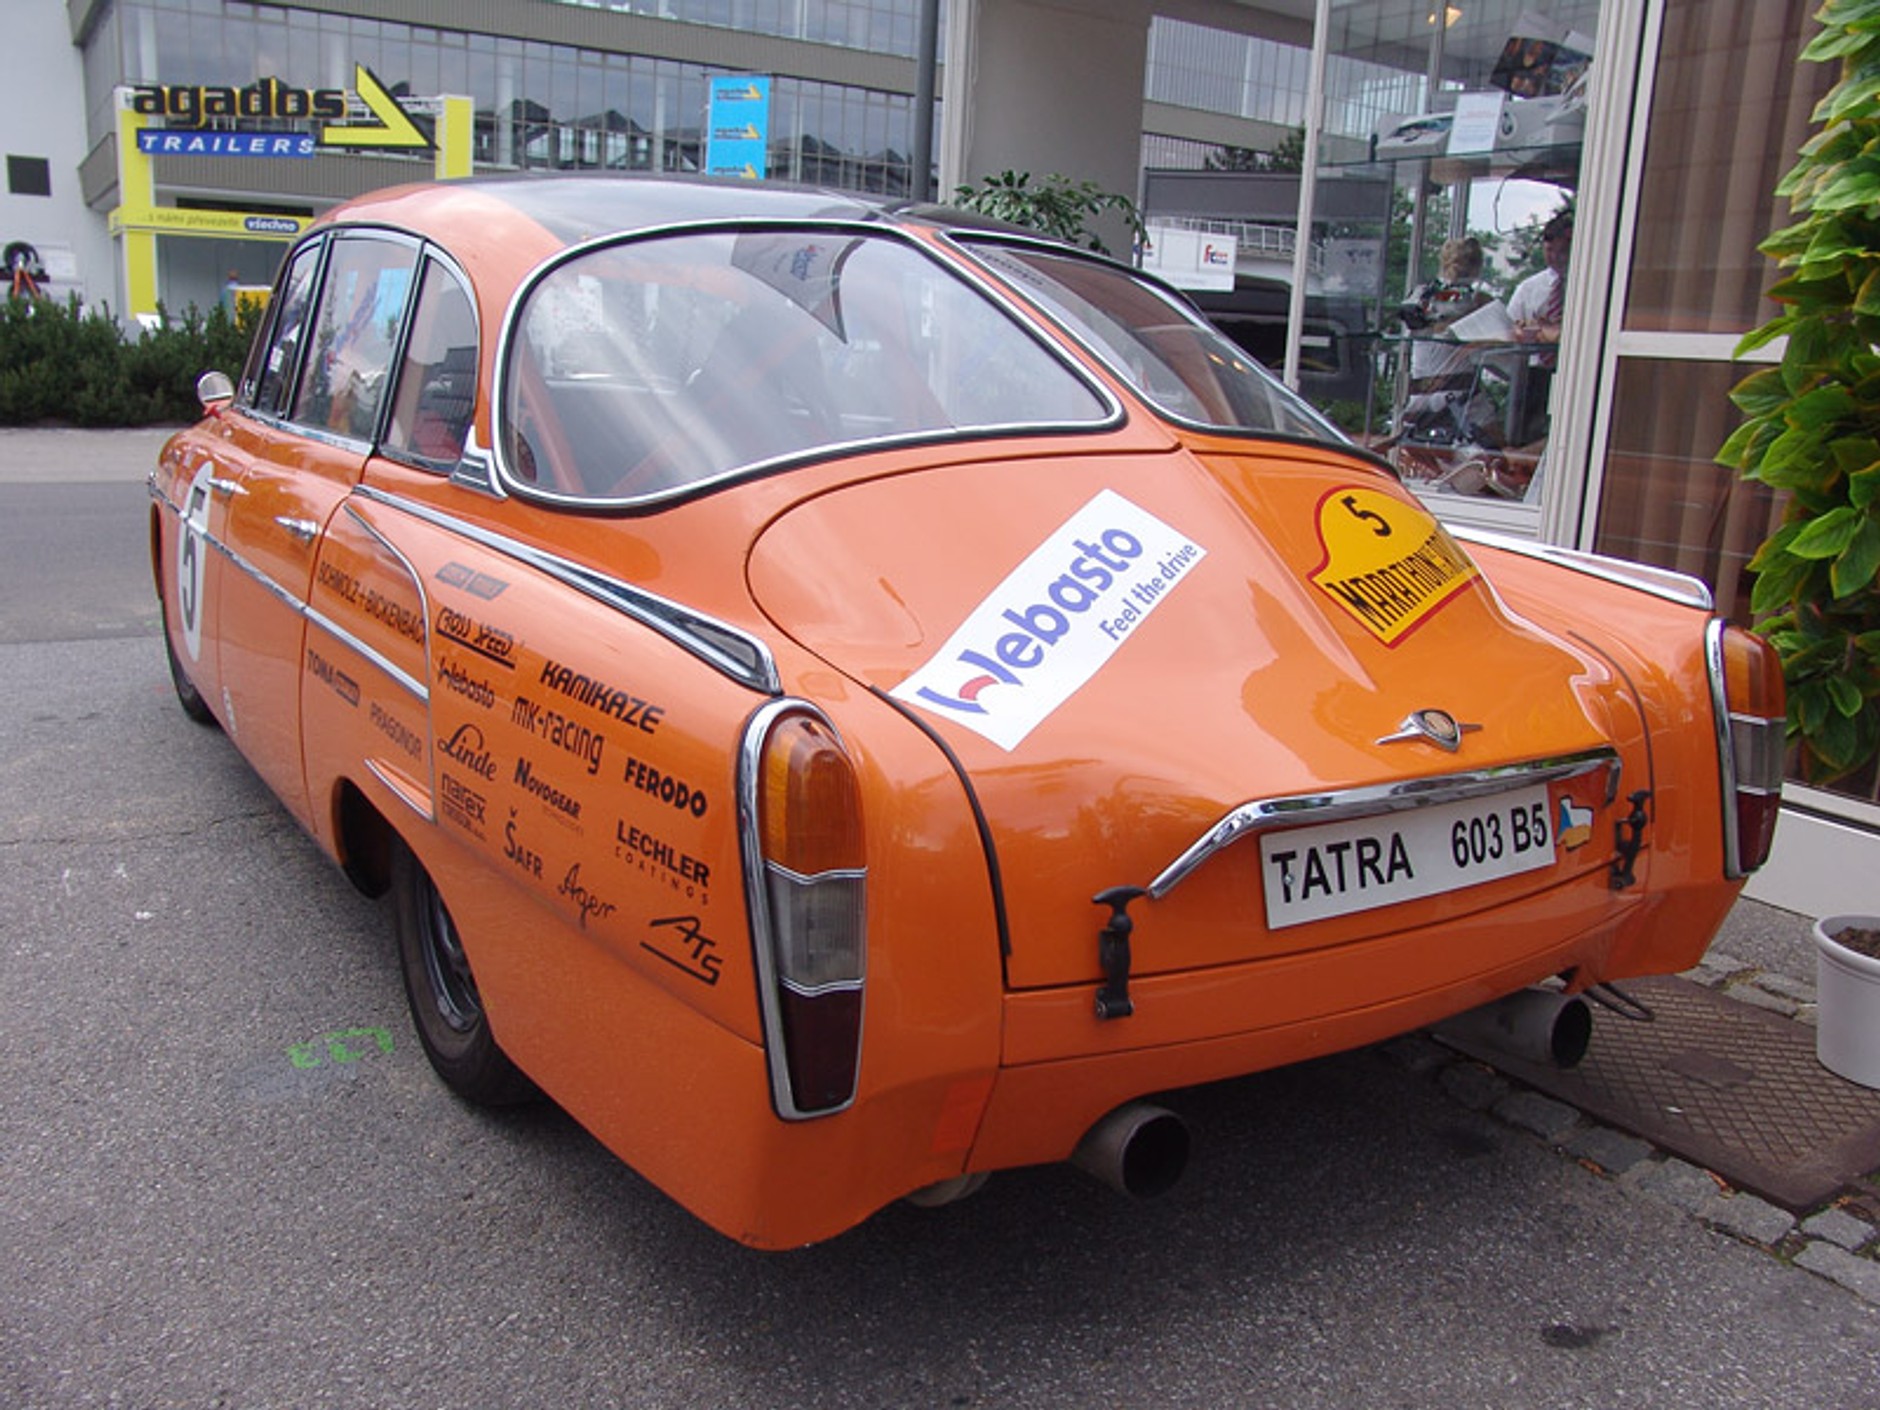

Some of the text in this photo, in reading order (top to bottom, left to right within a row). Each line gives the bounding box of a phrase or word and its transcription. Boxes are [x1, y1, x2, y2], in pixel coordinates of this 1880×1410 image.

[134, 77, 347, 127] agados
[142, 134, 315, 154] TRAILERS
[247, 217, 297, 232] všechno
[1341, 496, 1392, 537] 5
[182, 485, 206, 632] 5
[1325, 550, 1450, 633] MARATHON
[916, 528, 1144, 716] Webasto
[1100, 544, 1198, 641] Feel the drive
[540, 660, 664, 733] KAMIKAZE
[437, 723, 498, 782] Linde
[441, 772, 488, 826] narex
[624, 757, 707, 818] FERODO
[617, 819, 710, 888] LECHLER
[1271, 831, 1414, 903] TATRA
[1450, 803, 1548, 870] 603 B5
[615, 845, 709, 906] COATINGS
[640, 915, 724, 986] ATS
